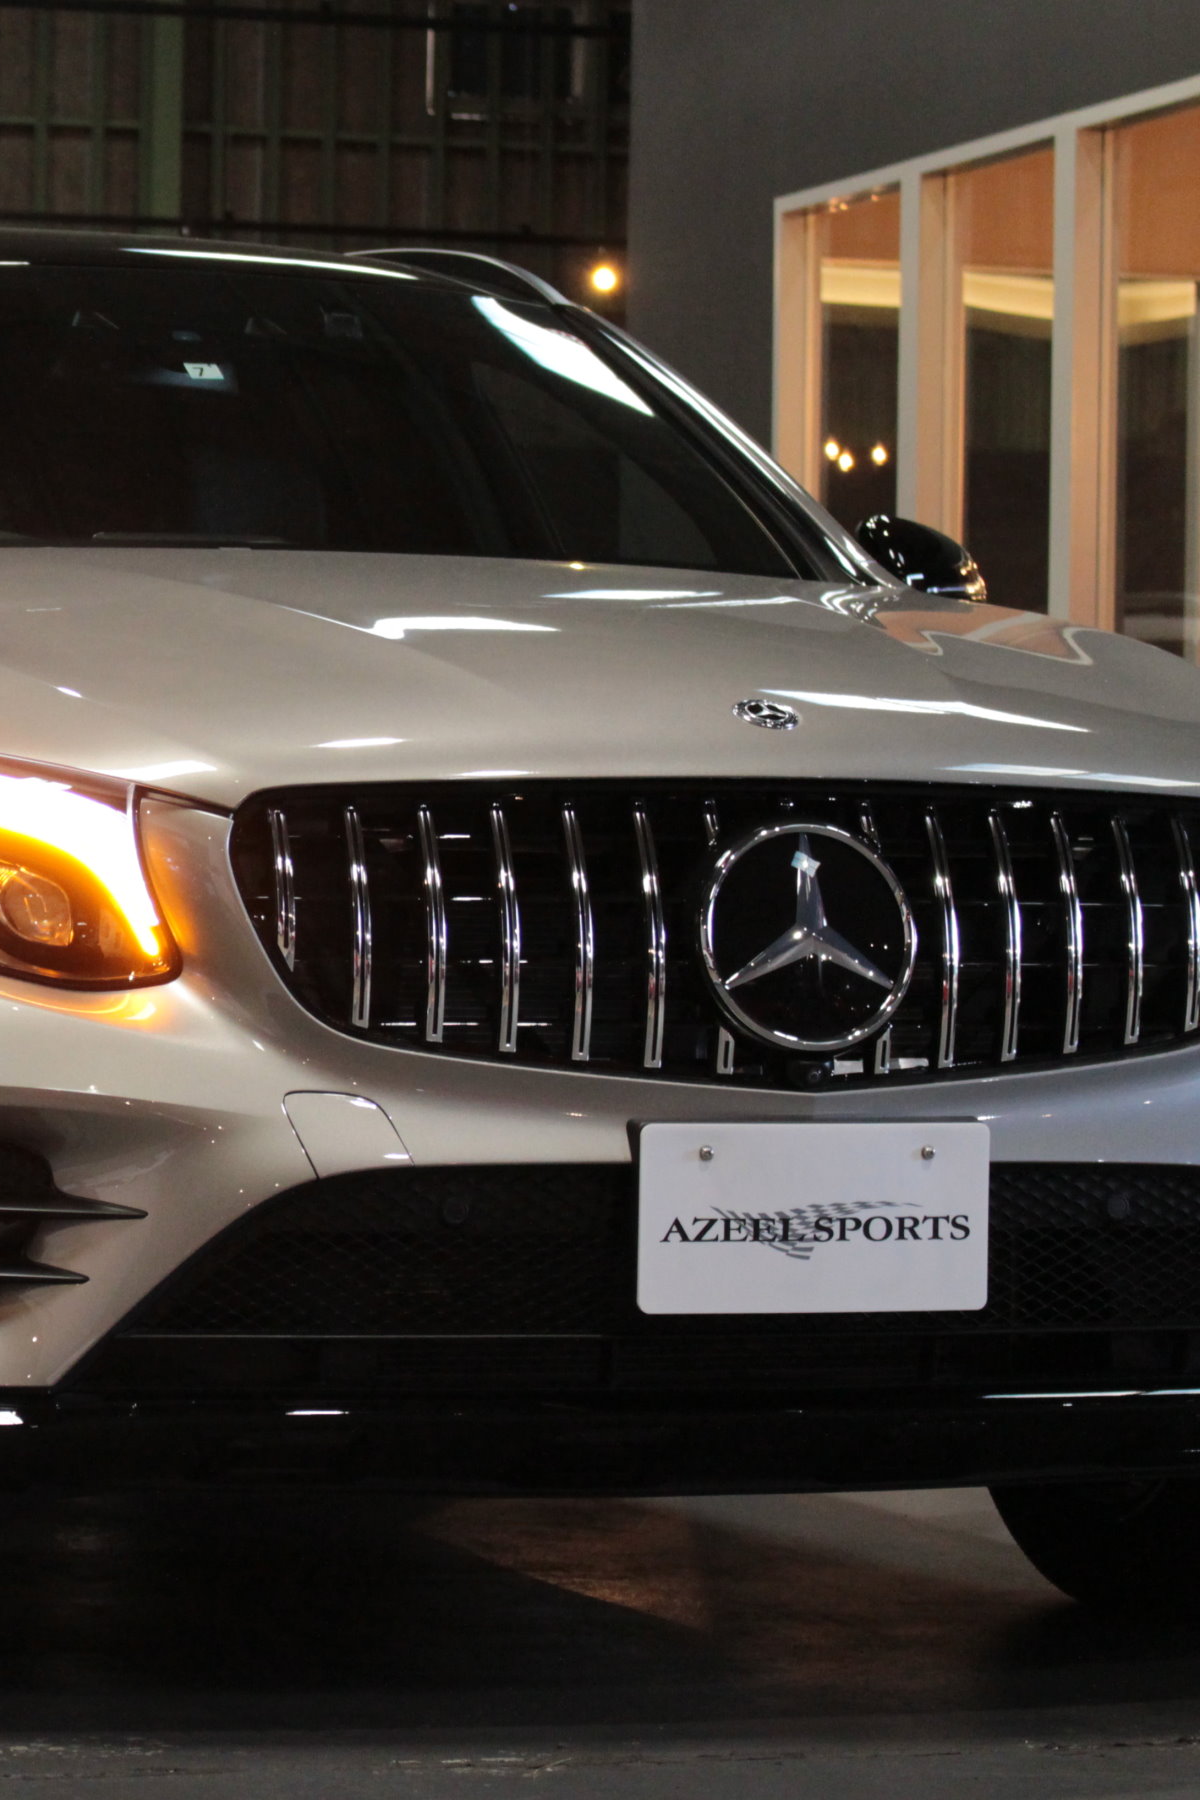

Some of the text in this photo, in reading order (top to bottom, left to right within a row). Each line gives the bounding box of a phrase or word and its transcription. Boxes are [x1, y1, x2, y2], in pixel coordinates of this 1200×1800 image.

[192, 366, 204, 377] 7
[660, 1214, 971, 1243] AZEEL SPORTS
